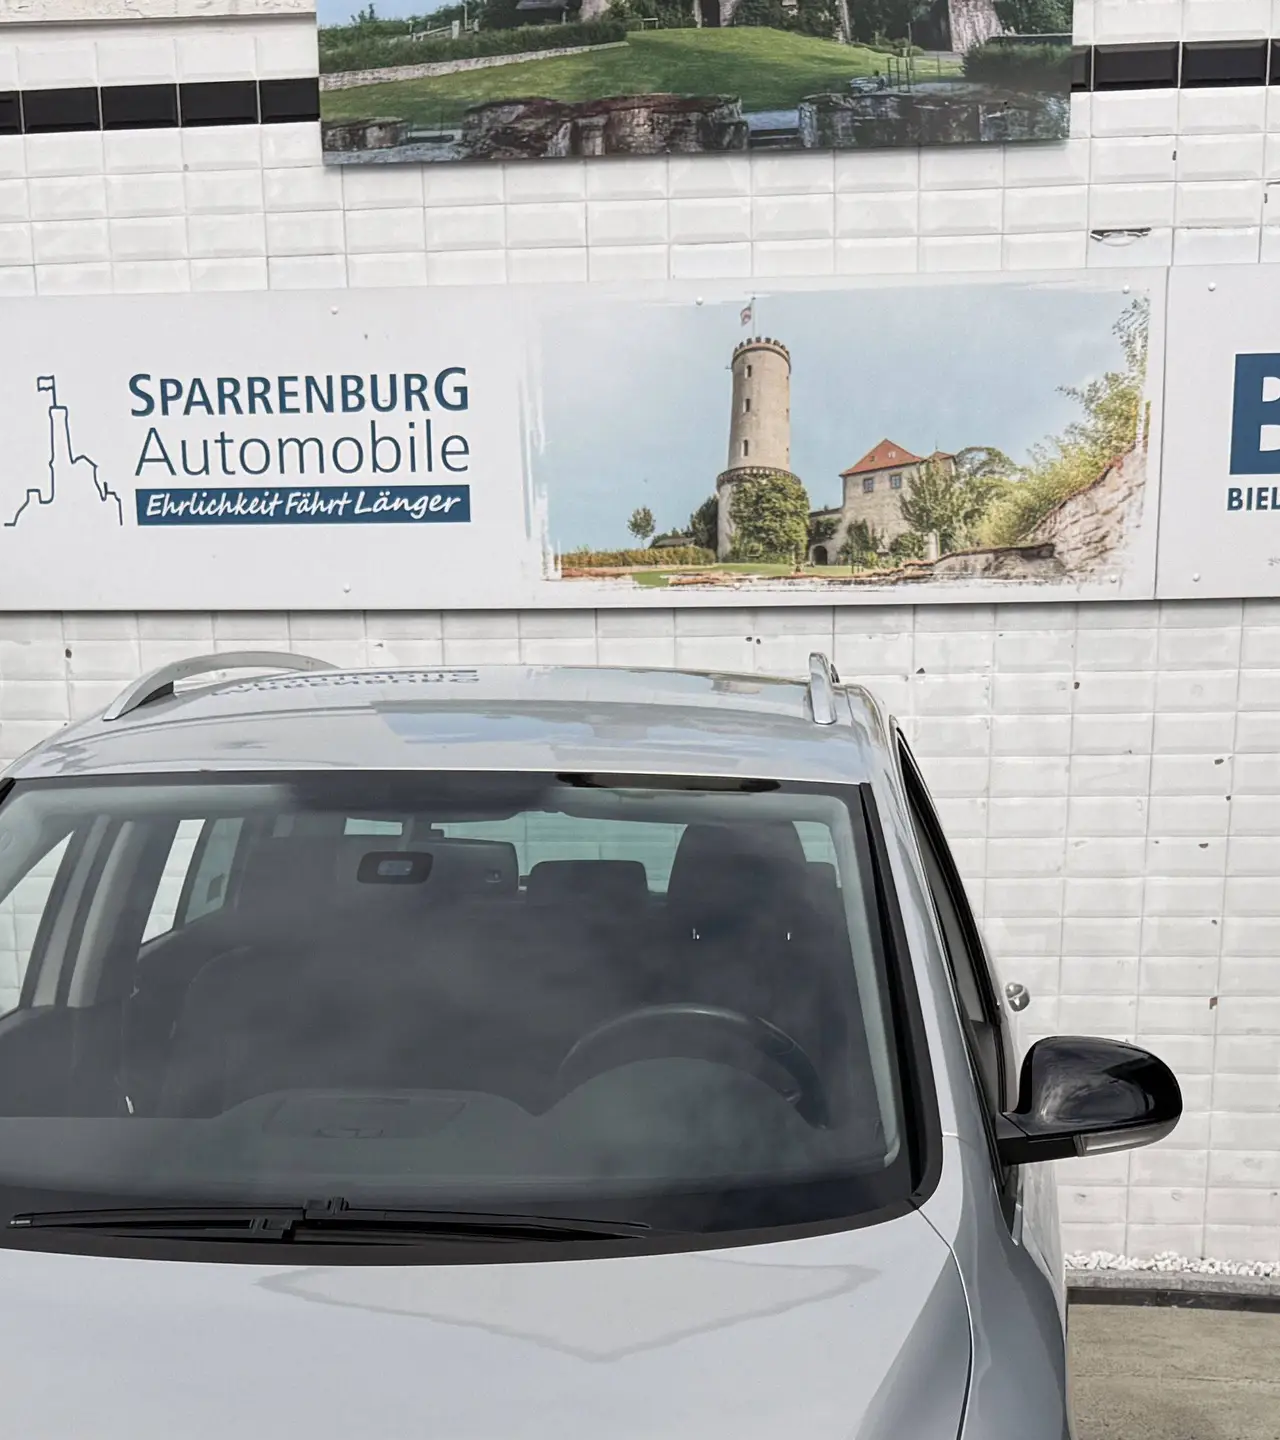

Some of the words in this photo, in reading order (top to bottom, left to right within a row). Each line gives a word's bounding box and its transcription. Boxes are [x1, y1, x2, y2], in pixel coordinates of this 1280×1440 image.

[129, 367, 468, 417] SPARRENBURG
[135, 419, 469, 476] Automobile
[146, 491, 282, 517] Ehrlichkeit
[285, 490, 351, 516] Fährt
[353, 490, 461, 519] Länger
